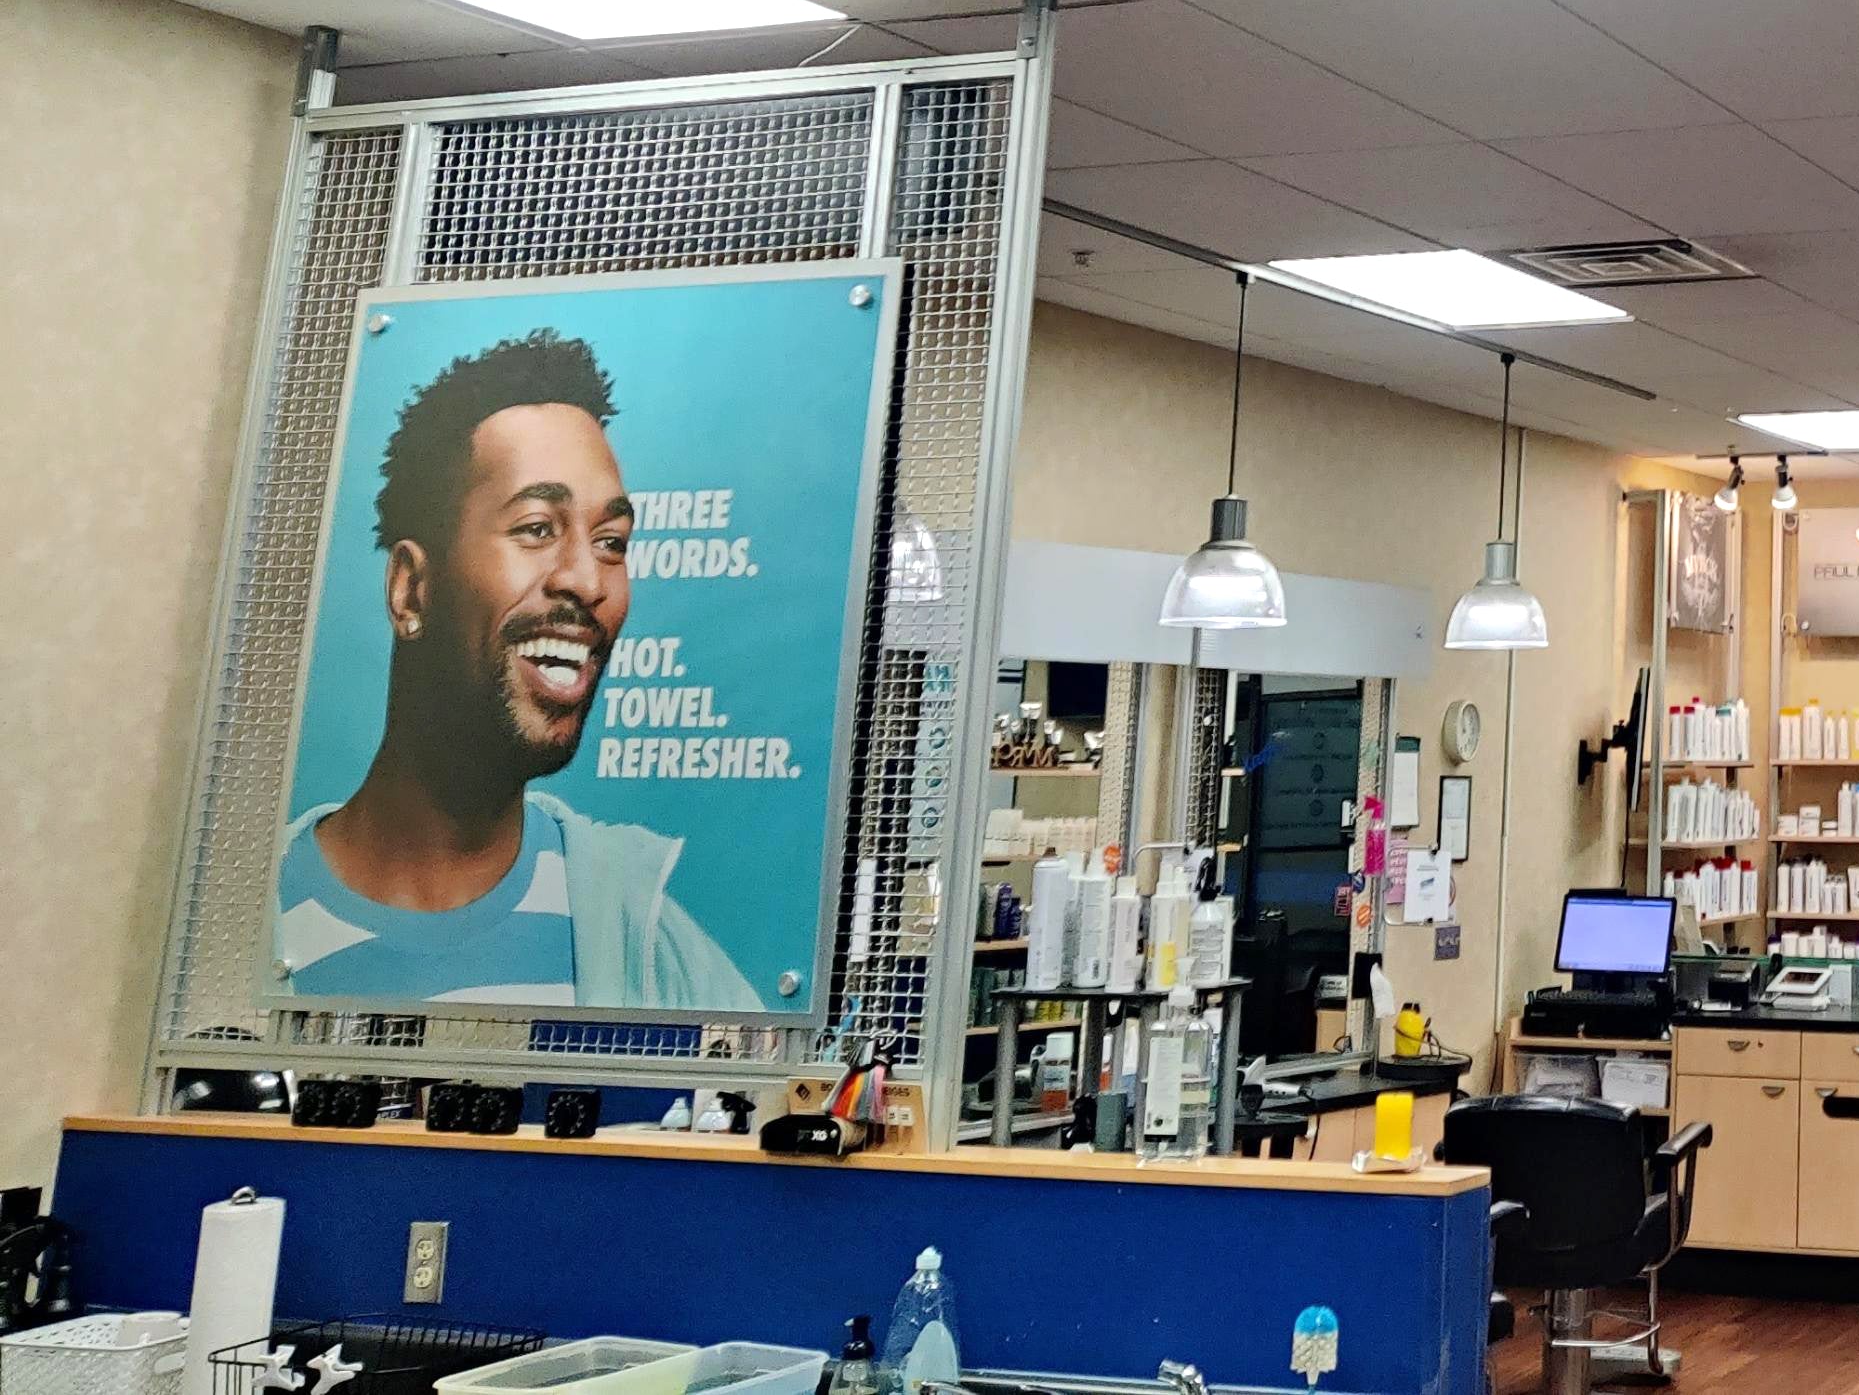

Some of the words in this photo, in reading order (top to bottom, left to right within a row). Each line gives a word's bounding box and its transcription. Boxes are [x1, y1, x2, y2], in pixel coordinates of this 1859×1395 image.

[630, 489, 734, 531] THREE
[625, 536, 760, 580] WORDS.
[1813, 563, 1854, 580] PAUL
[607, 636, 687, 678] HOT.
[603, 686, 729, 728] TOWEL.
[596, 737, 802, 779] REFRESHER.
[811, 1129, 828, 1142] XG
